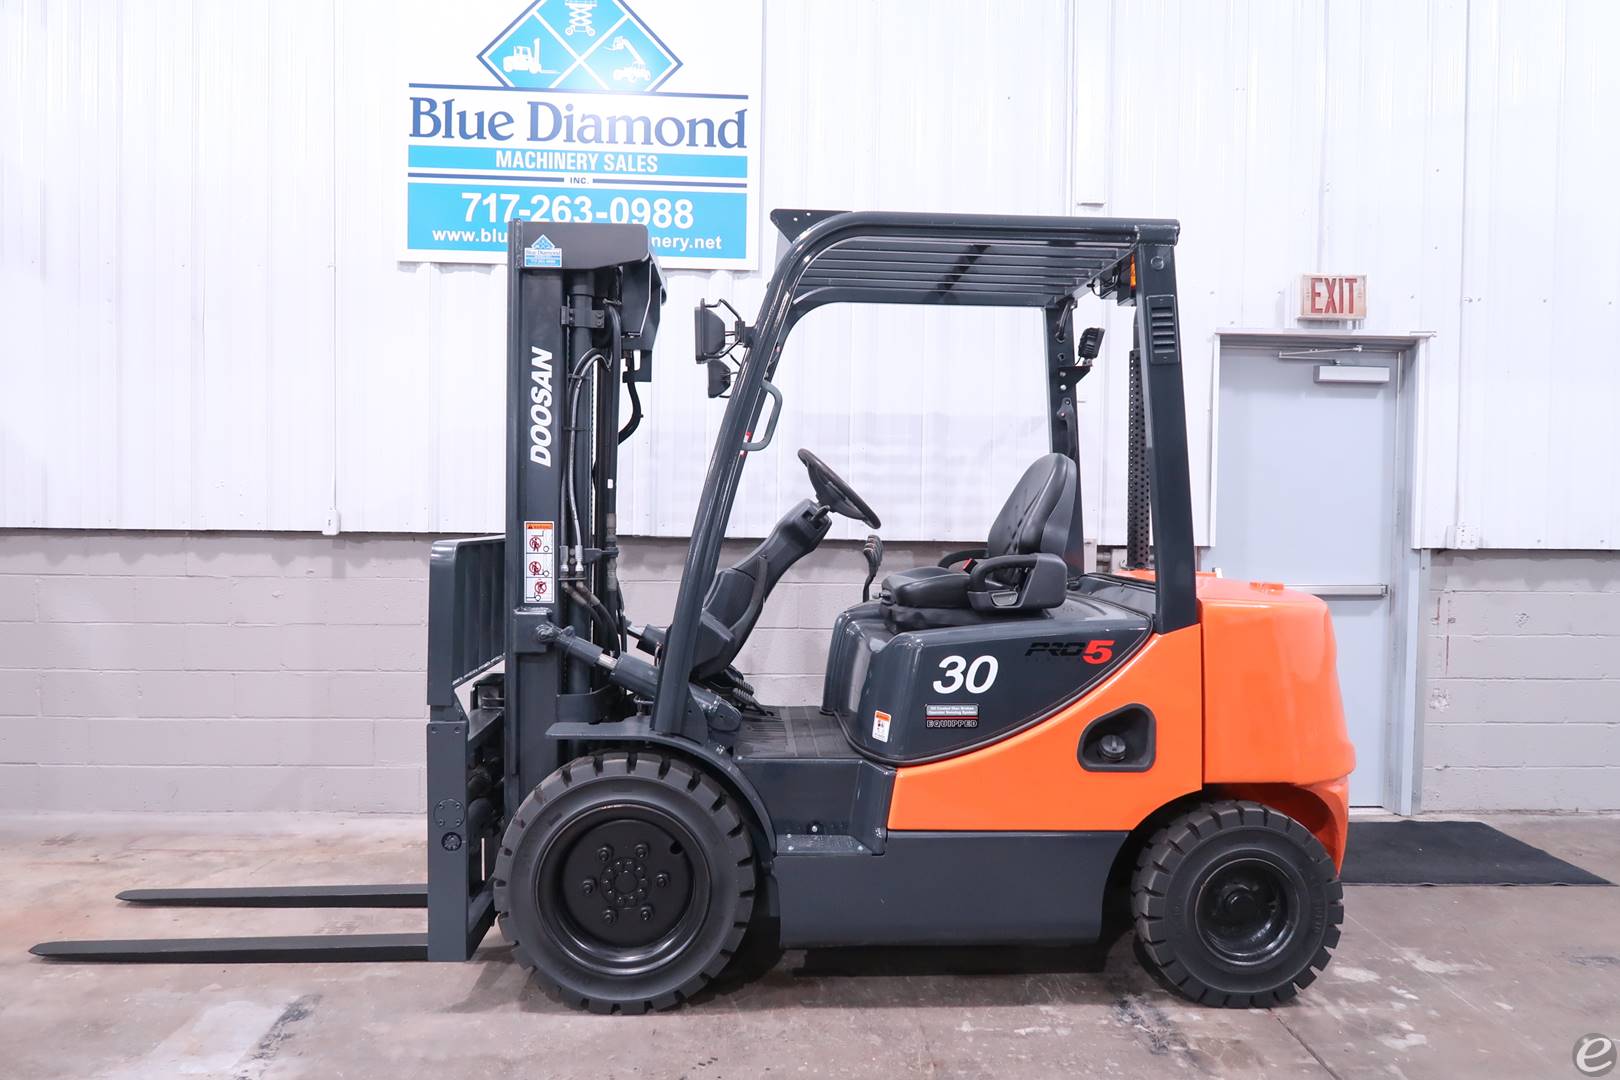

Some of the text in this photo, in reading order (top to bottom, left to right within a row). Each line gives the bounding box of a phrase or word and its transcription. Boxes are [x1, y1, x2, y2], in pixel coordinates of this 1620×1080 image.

[409, 97, 747, 149] Blue Diamond
[496, 150, 658, 173] MACHINERY SALES
[462, 192, 693, 229] 717-263-0988
[1311, 277, 1358, 314] EXIT
[530, 346, 552, 467] DOOSAN
[933, 655, 999, 694] 30
[926, 720, 978, 728] EQUIPPED
